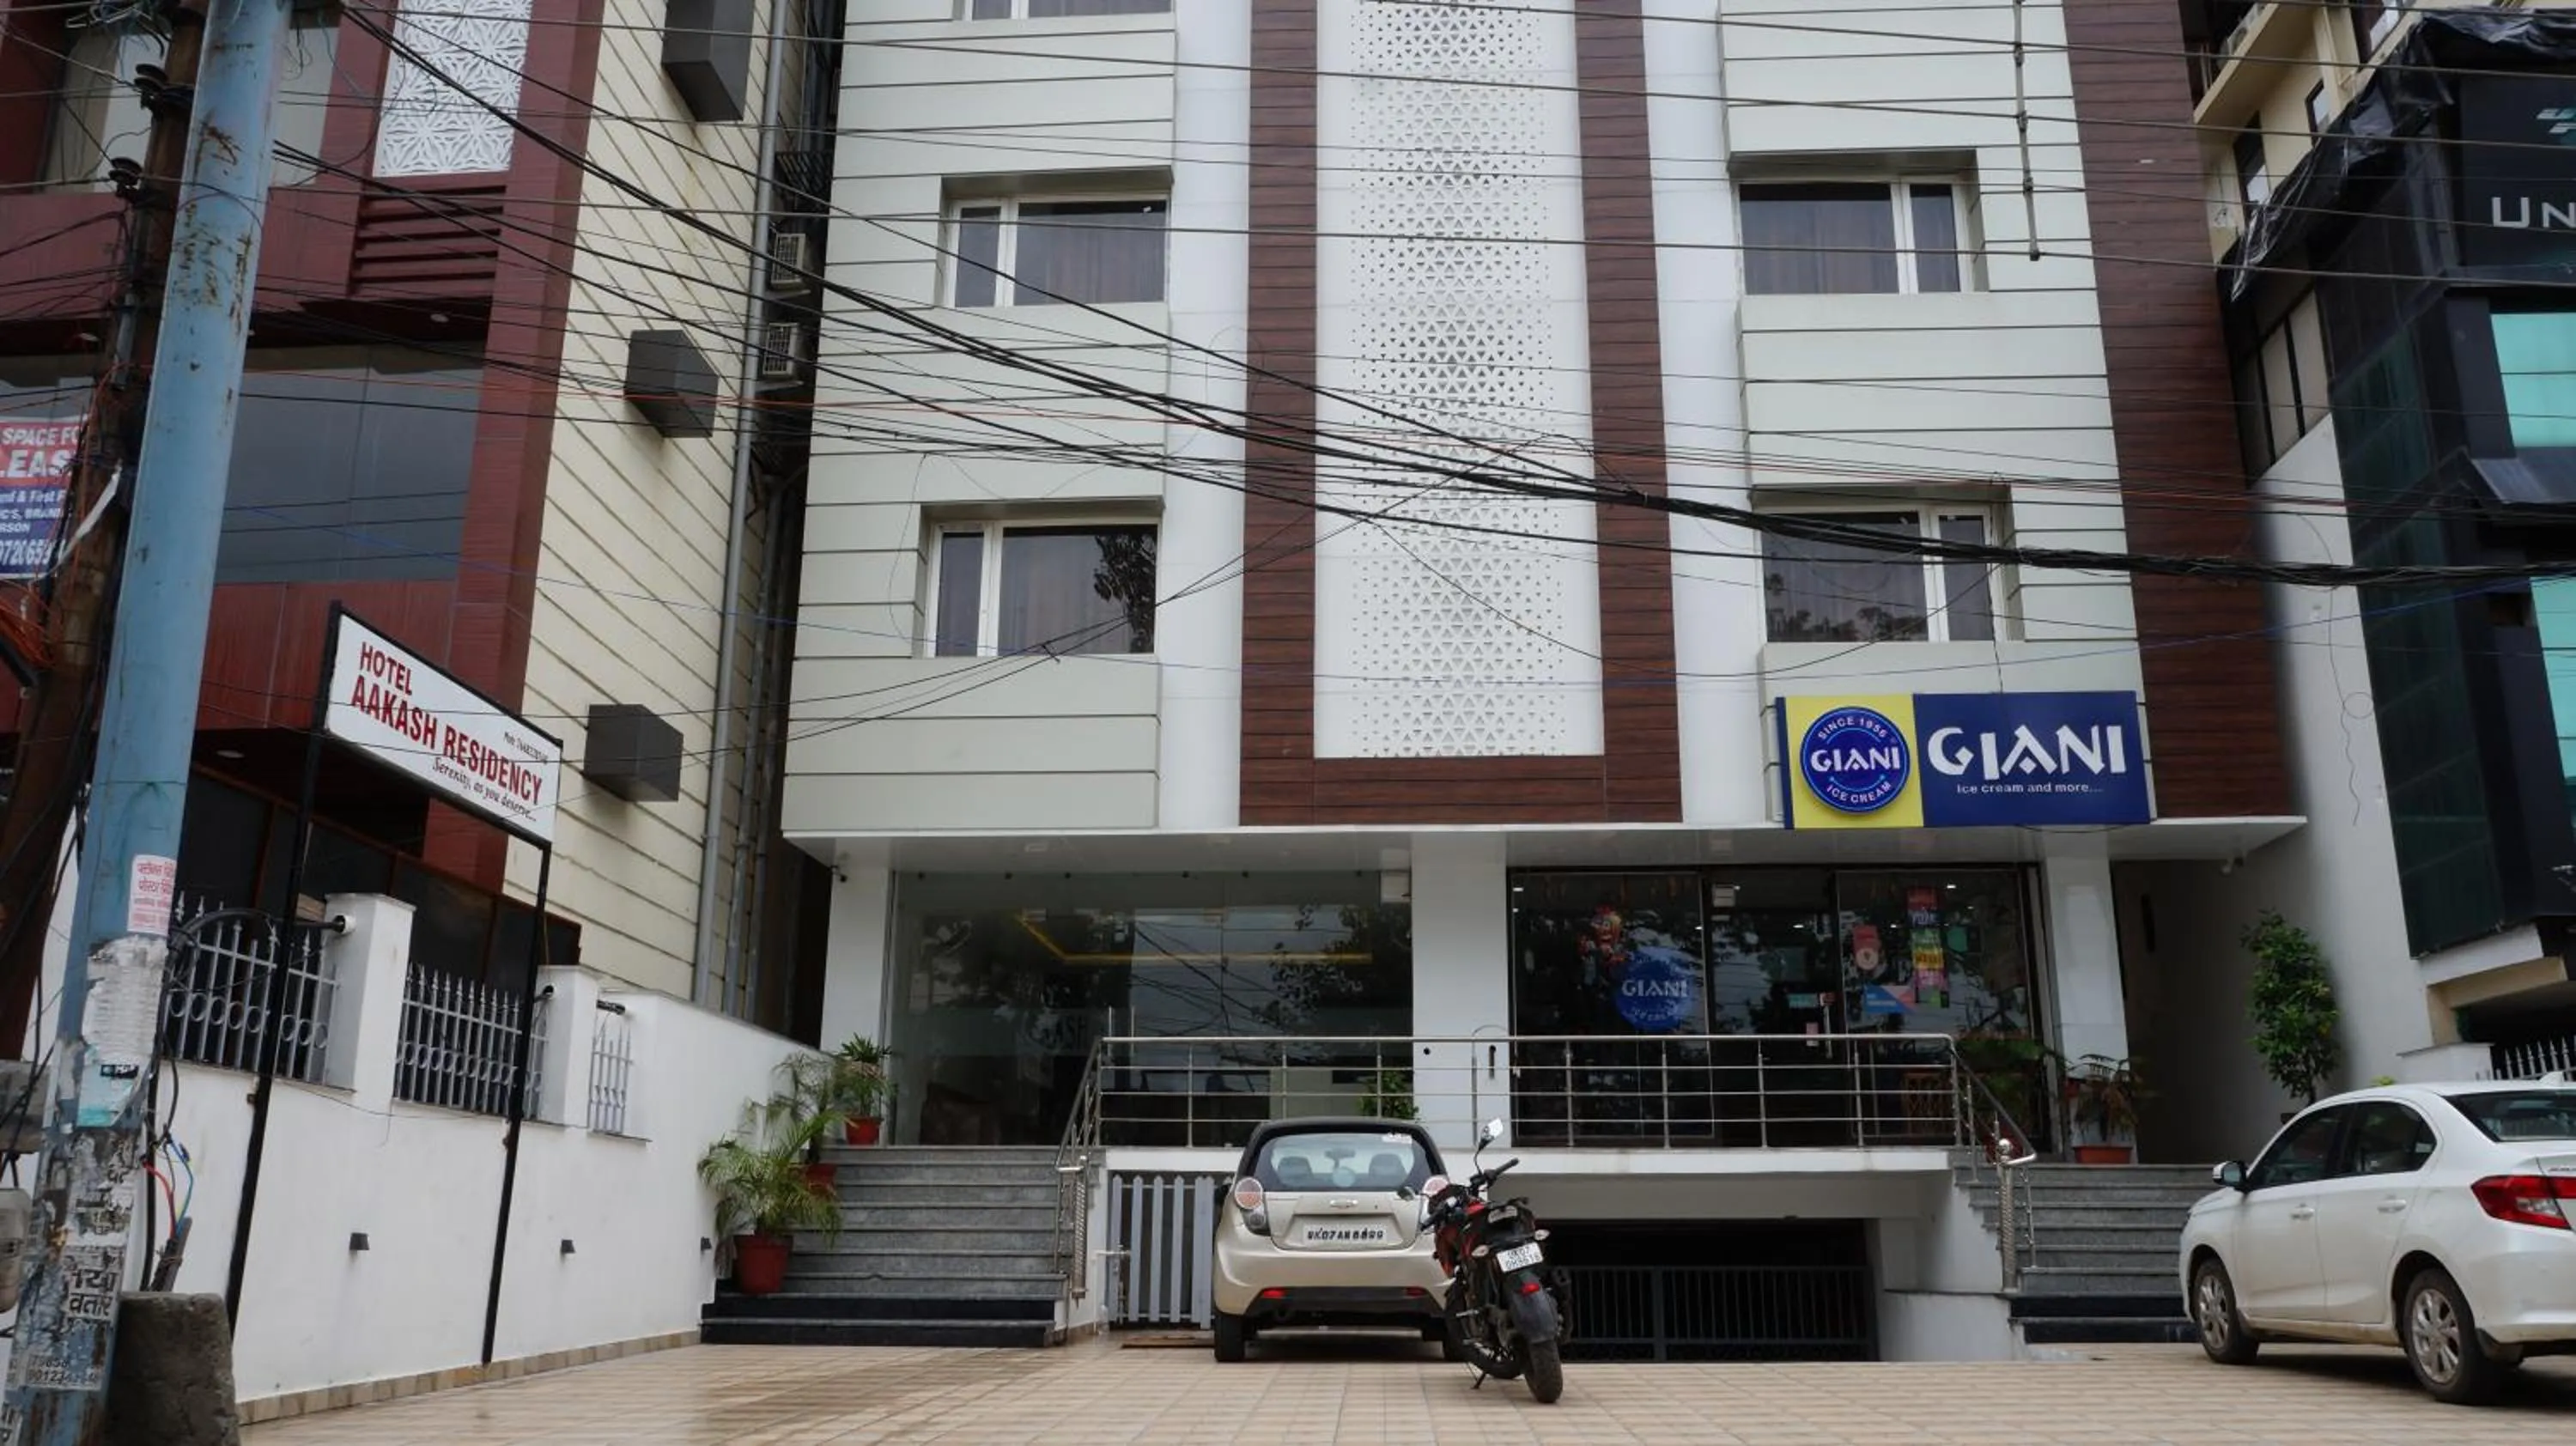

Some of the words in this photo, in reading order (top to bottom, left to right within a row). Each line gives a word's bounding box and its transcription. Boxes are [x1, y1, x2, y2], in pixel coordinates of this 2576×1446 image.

[2, 427, 58, 446] SPACE
[61, 425, 81, 446] FO
[0, 448, 73, 478] EAS
[359, 641, 412, 696] HOTEL
[1817, 716, 1855, 739] SINCE
[350, 675, 438, 749] AAKASH
[442, 725, 543, 805] RESIDENCY
[1810, 745, 1900, 771] GIANI
[1927, 724, 2127, 781] GIANI
[483, 787, 501, 803] you
[1826, 784, 1849, 801] ICE
[1850, 781, 1893, 804] CREAM
[1980, 784, 2024, 794] cream
[2026, 781, 2052, 793] and
[1620, 978, 1689, 998] GIANI
